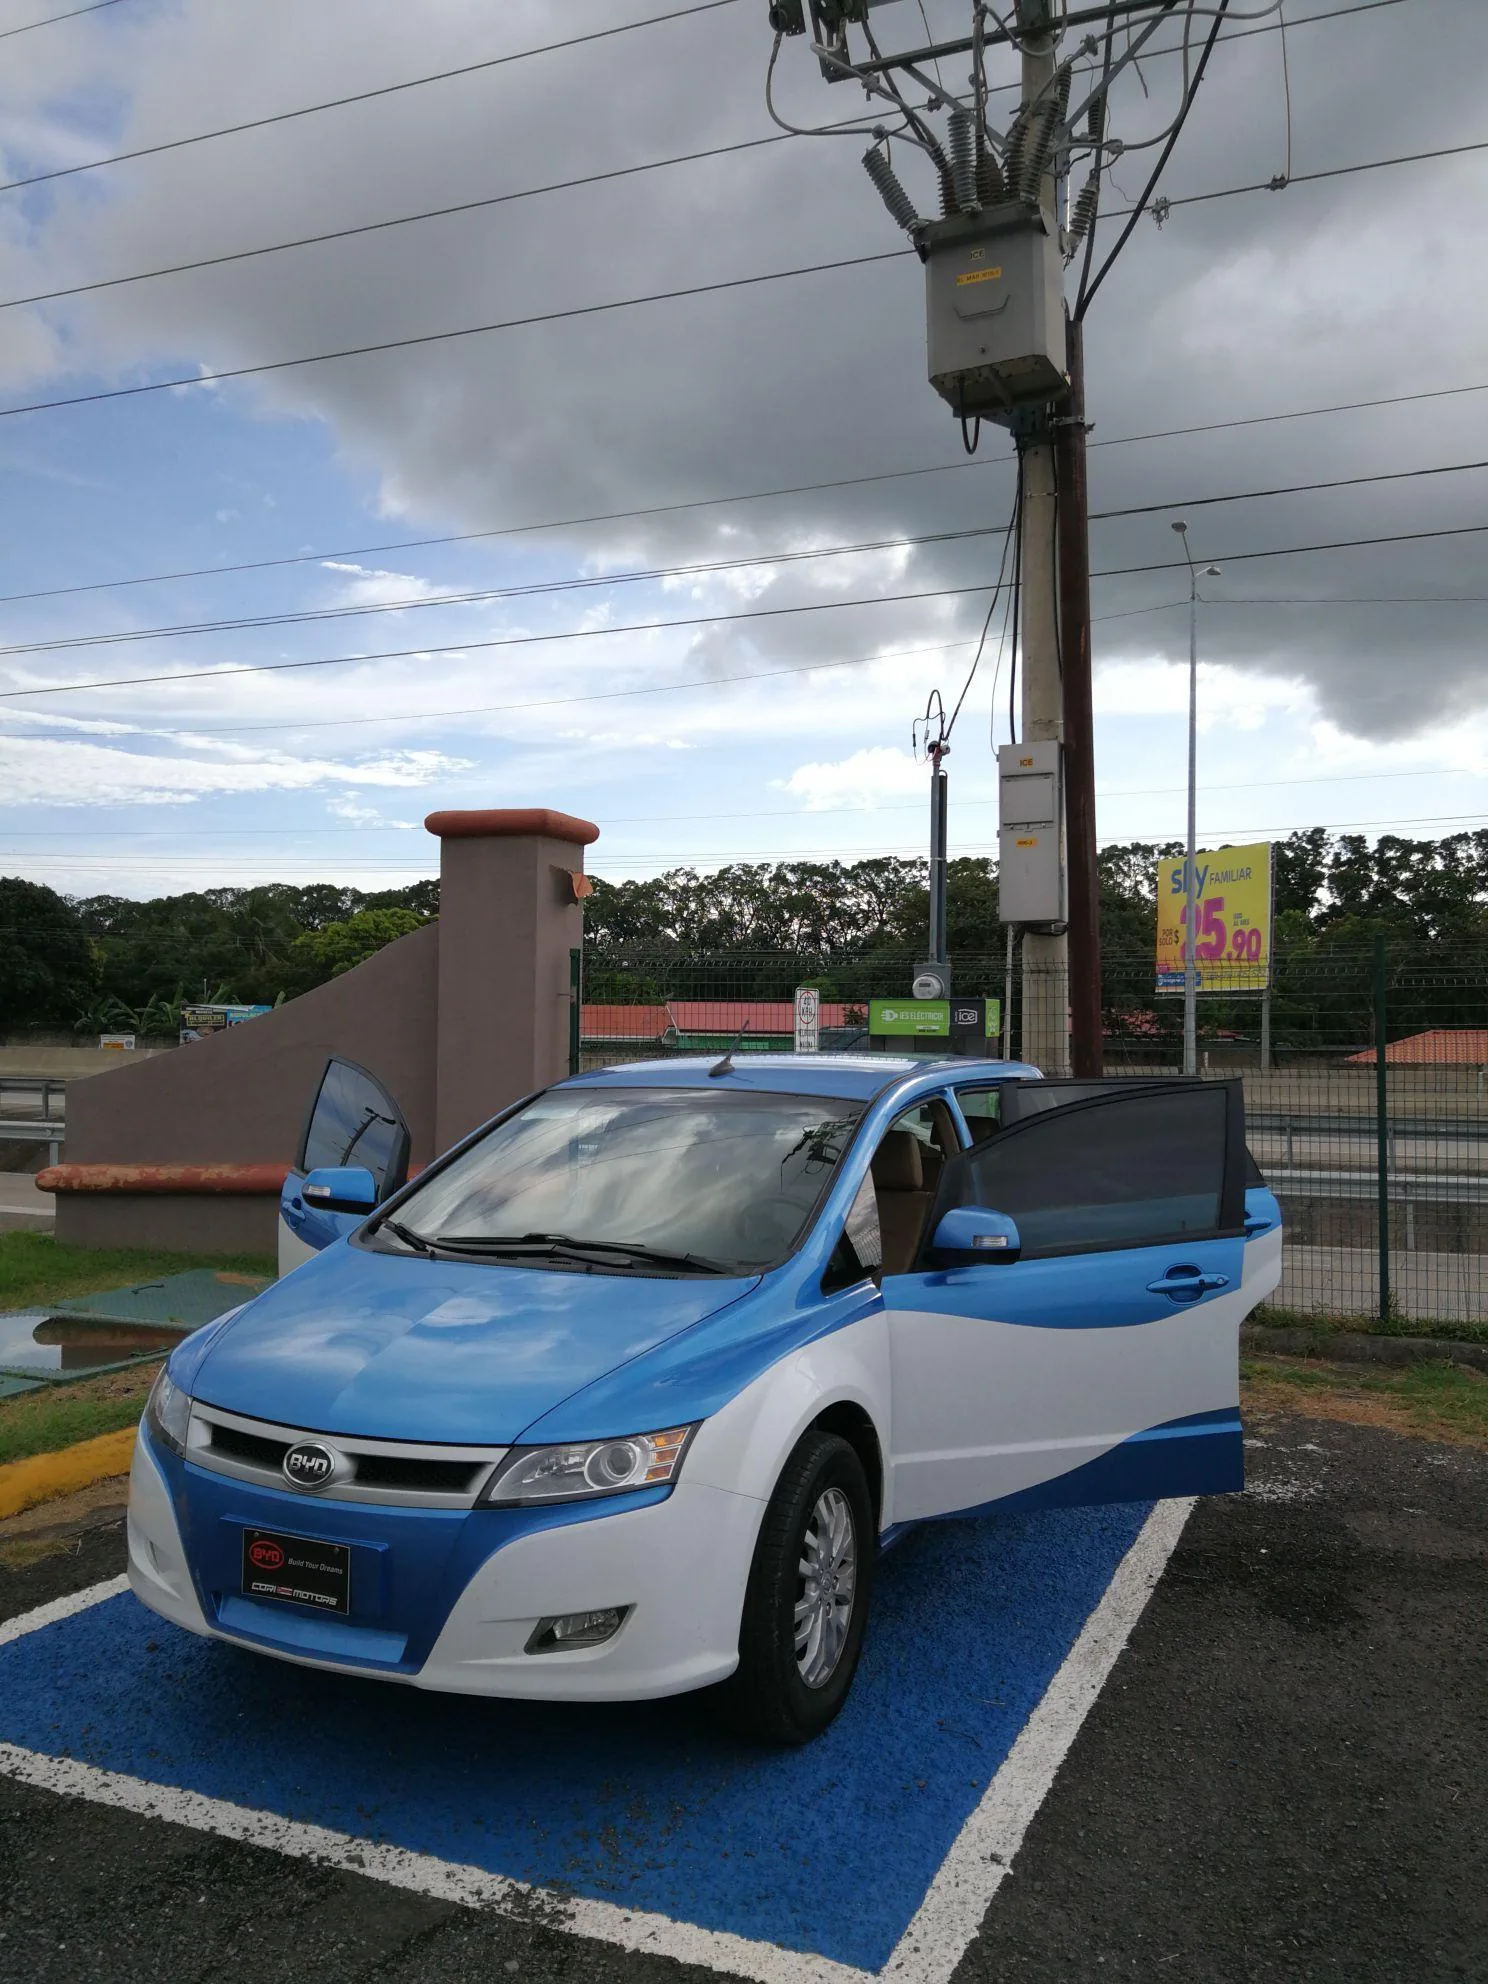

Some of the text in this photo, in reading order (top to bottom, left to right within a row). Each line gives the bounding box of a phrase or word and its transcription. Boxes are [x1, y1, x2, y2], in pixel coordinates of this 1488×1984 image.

[1210, 867, 1252, 885] FAMILIAR
[1162, 928, 1173, 937] POR
[1158, 938, 1173, 946] SOLO
[288, 1453, 329, 1476] BYD
[252, 1547, 280, 1562] BYD
[288, 1558, 343, 1575] Build Your Dreams
[251, 1582, 338, 1606] CORI MOTORS
